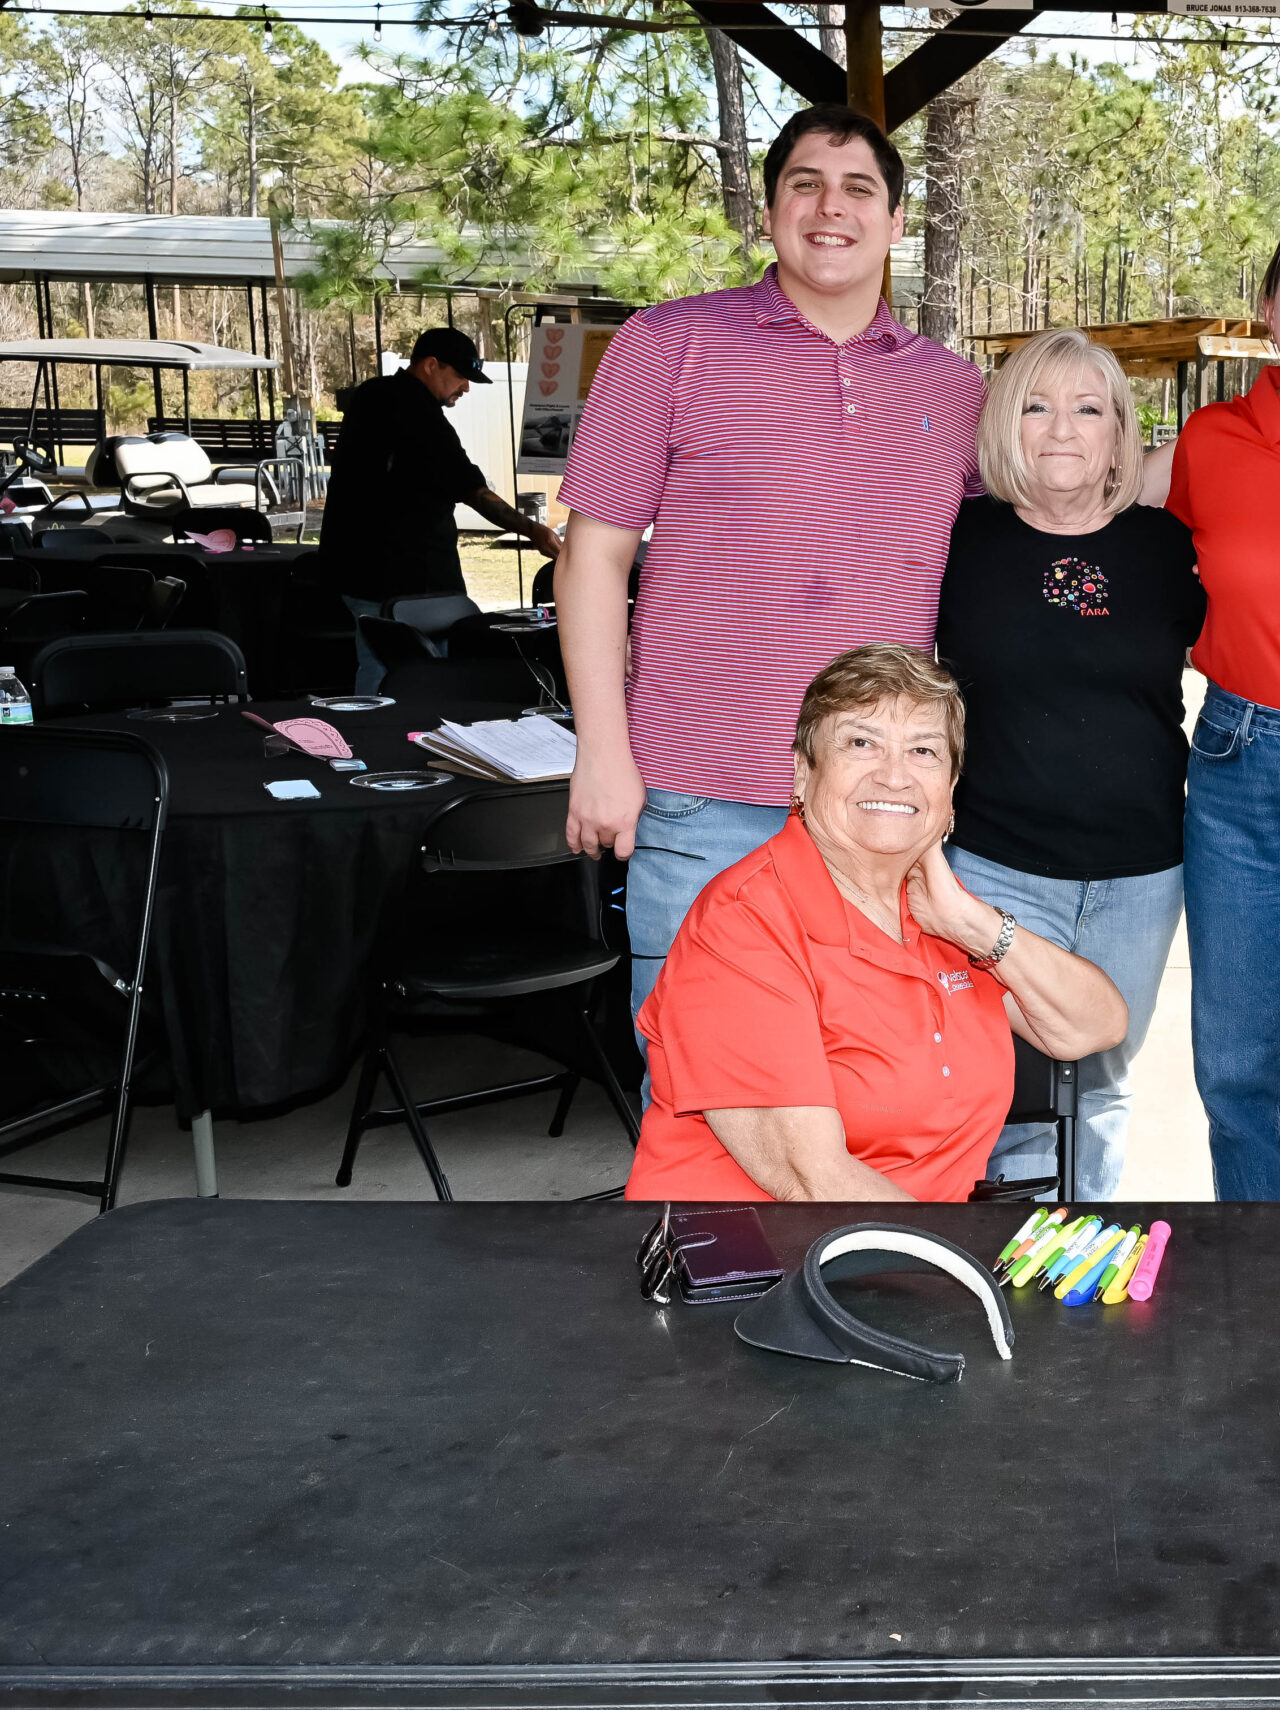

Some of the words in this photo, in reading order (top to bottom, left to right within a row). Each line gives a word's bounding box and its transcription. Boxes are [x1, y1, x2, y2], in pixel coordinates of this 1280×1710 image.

[1186, 4, 1209, 12] BRUCE
[1209, 4, 1232, 12] JONAS
[1080, 607, 1110, 616] FARA
